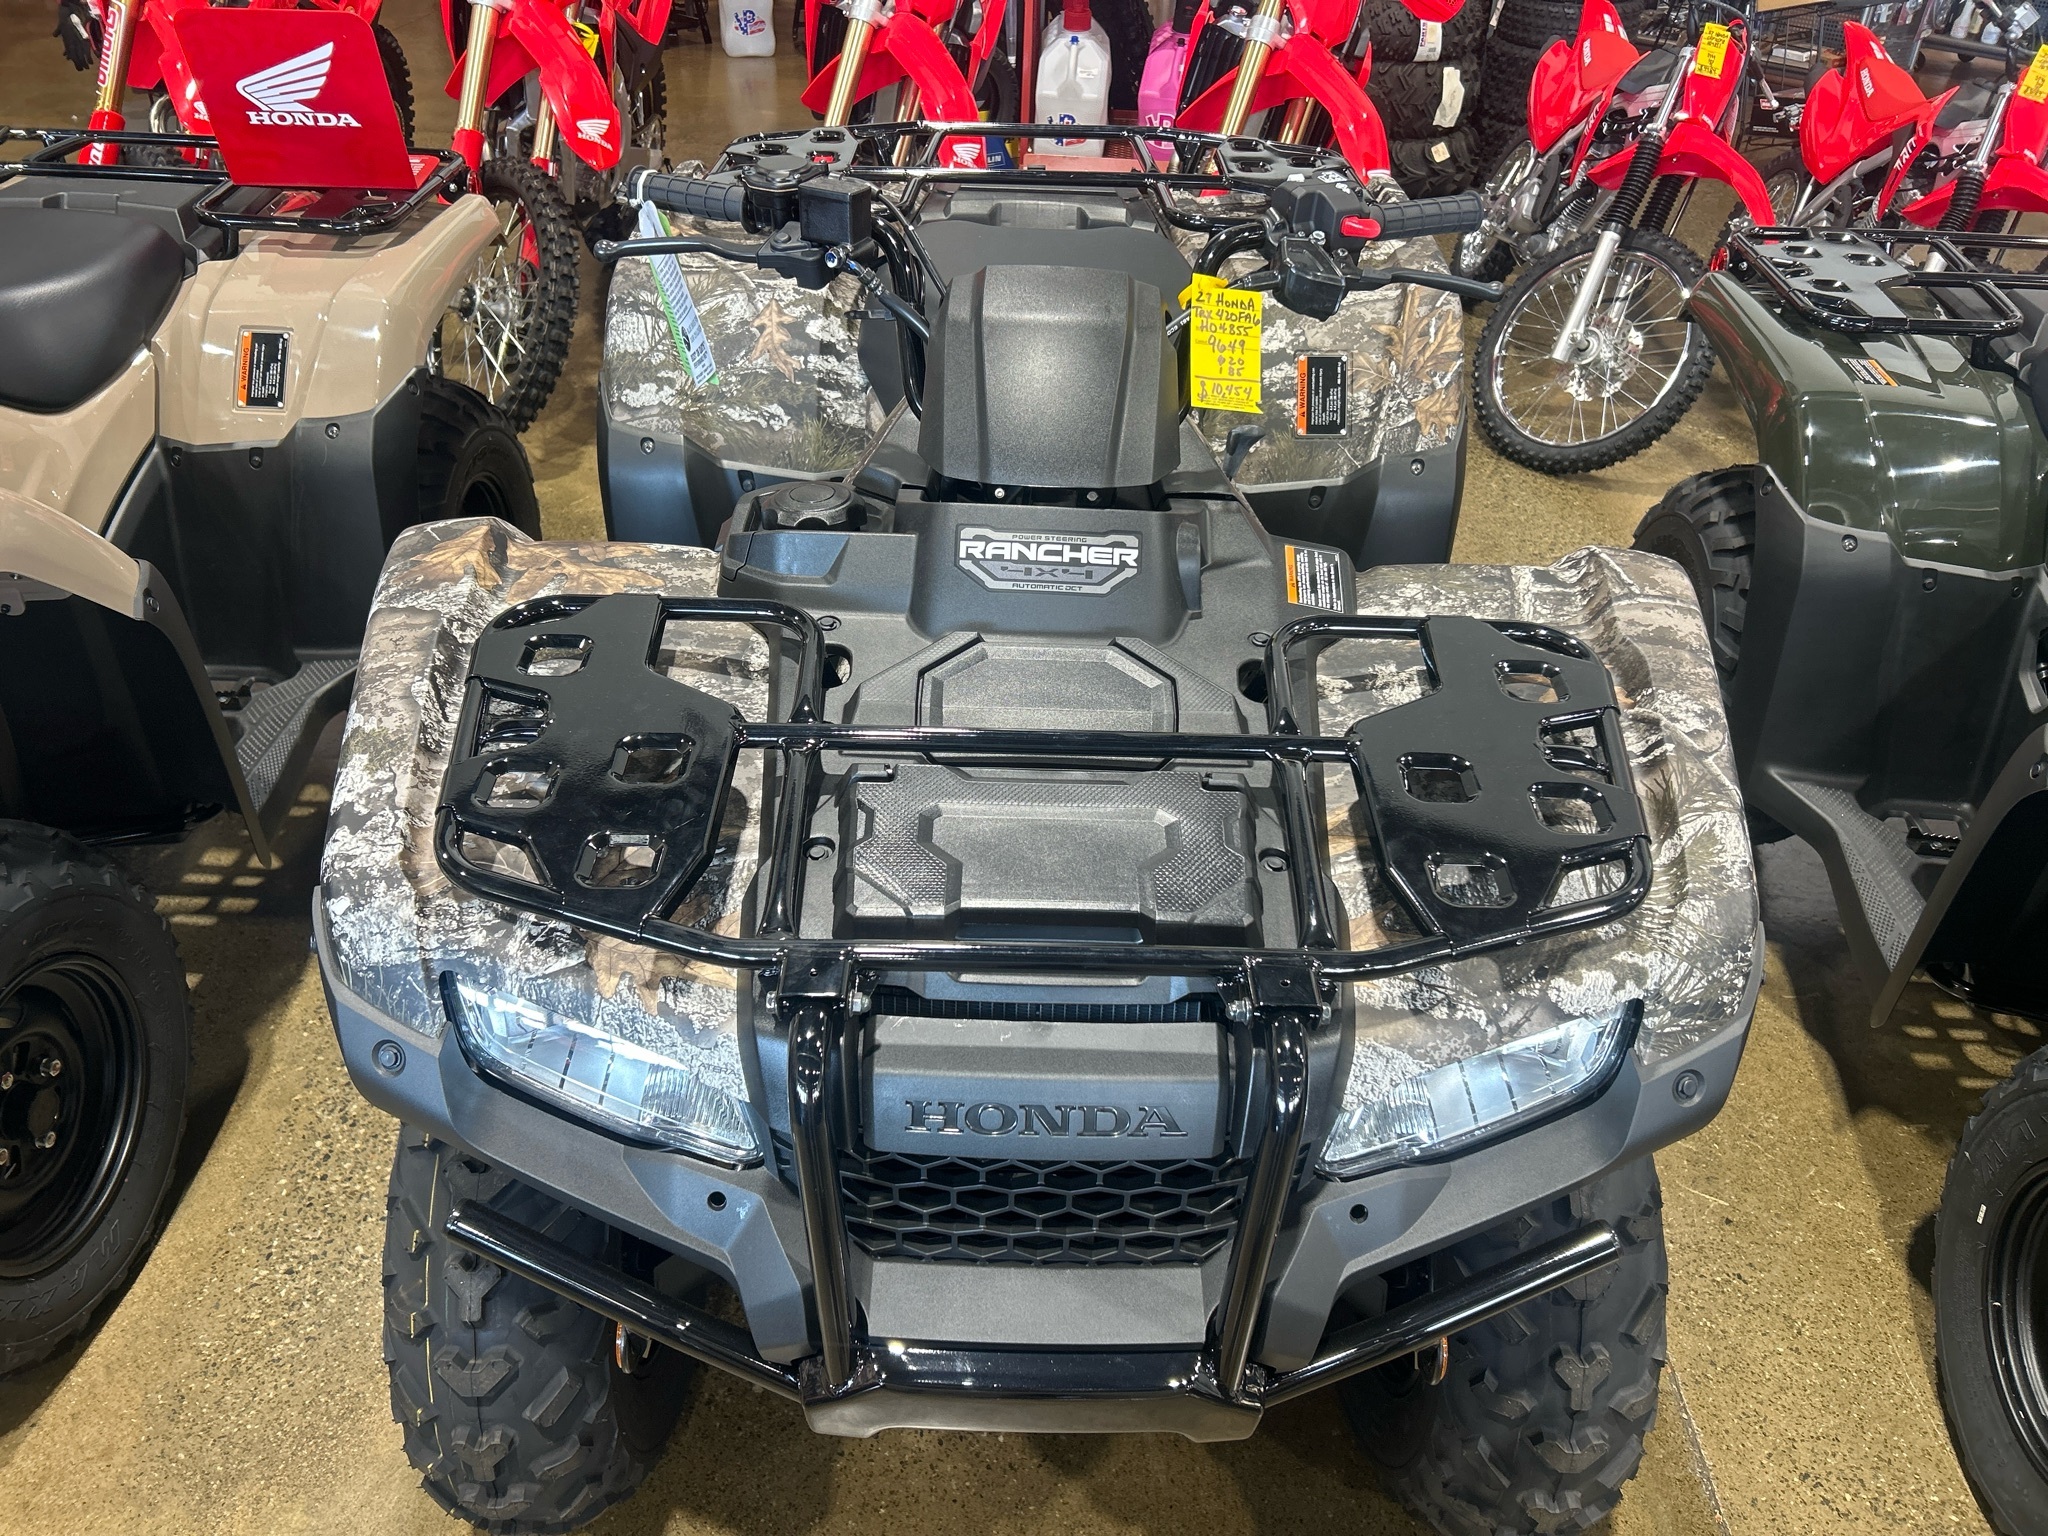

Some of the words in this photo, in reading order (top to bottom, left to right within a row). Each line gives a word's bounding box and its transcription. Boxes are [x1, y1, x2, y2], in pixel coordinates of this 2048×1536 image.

[246, 111, 362, 128] HONDA
[577, 132, 613, 151] HONDA
[1216, 292, 1255, 312] HONDA
[1207, 334, 1246, 355] 9649
[240, 347, 250, 383] WARNING
[1044, 535, 1088, 543] STEERING
[959, 540, 1139, 567] RANCHER
[1012, 582, 1064, 591] AUTOMATIC
[1065, 584, 1083, 592] DCT
[698, 1062, 737, 1076] ATERA
[905, 1100, 1189, 1138] HONDA
